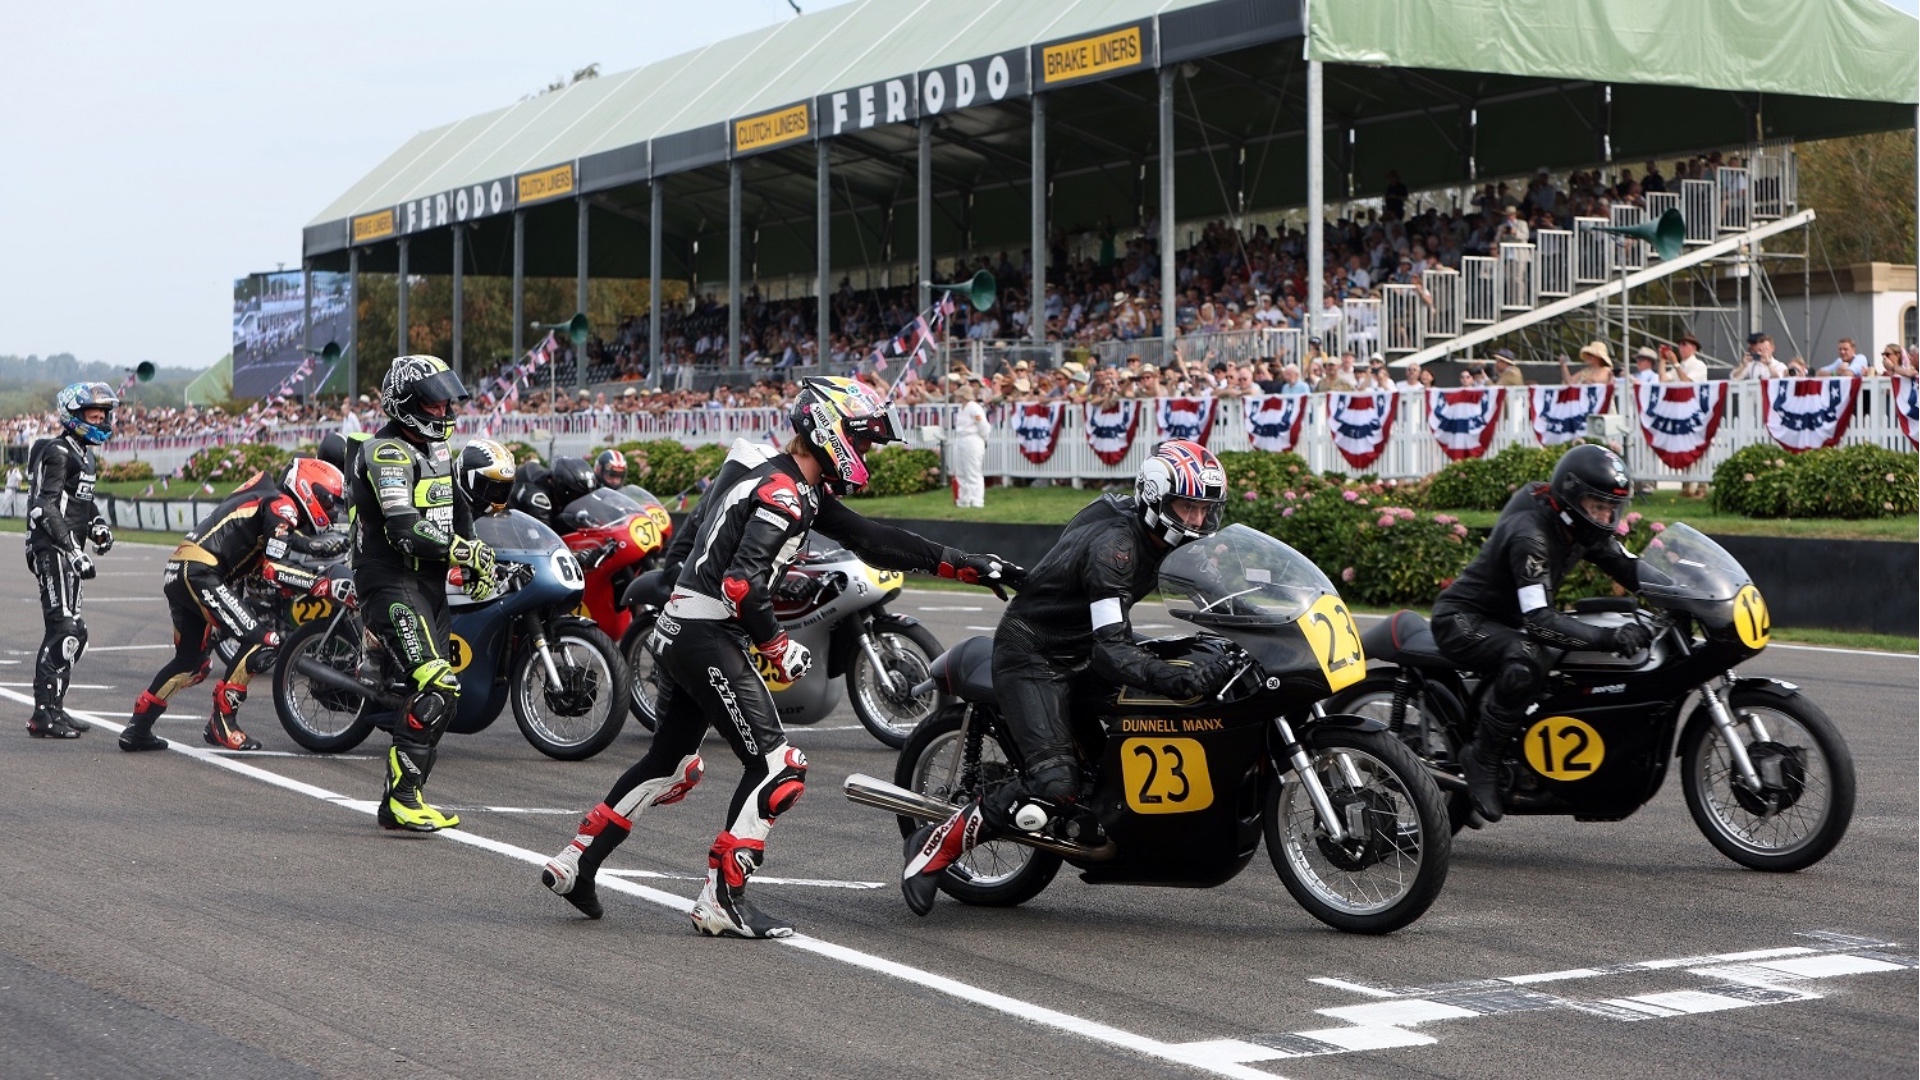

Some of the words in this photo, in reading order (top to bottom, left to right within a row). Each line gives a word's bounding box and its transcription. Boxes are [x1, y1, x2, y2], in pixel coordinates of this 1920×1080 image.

[1046, 43, 1089, 76] BRAKE
[1093, 34, 1138, 66] LINERS
[832, 55, 1010, 135] FERODO
[737, 117, 772, 146] CLUTCH
[774, 106, 806, 138] LINERS
[520, 178, 546, 197] CLUTCH
[546, 170, 571, 191] LINERS
[355, 219, 373, 237] BRAKE
[373, 214, 392, 233] LINERS
[406, 180, 504, 234] FERODO
[634, 521, 657, 546] 37
[296, 600, 333, 624] 22
[1741, 589, 1770, 642] 12
[1310, 604, 1362, 674] 23
[1268, 679, 1279, 689] 90
[707, 666, 759, 756] alpinestars
[1121, 719, 1178, 733] DUNNELL
[1182, 718, 1225, 731] MANX
[1537, 725, 1592, 772] 12
[1133, 744, 1190, 804] 23
